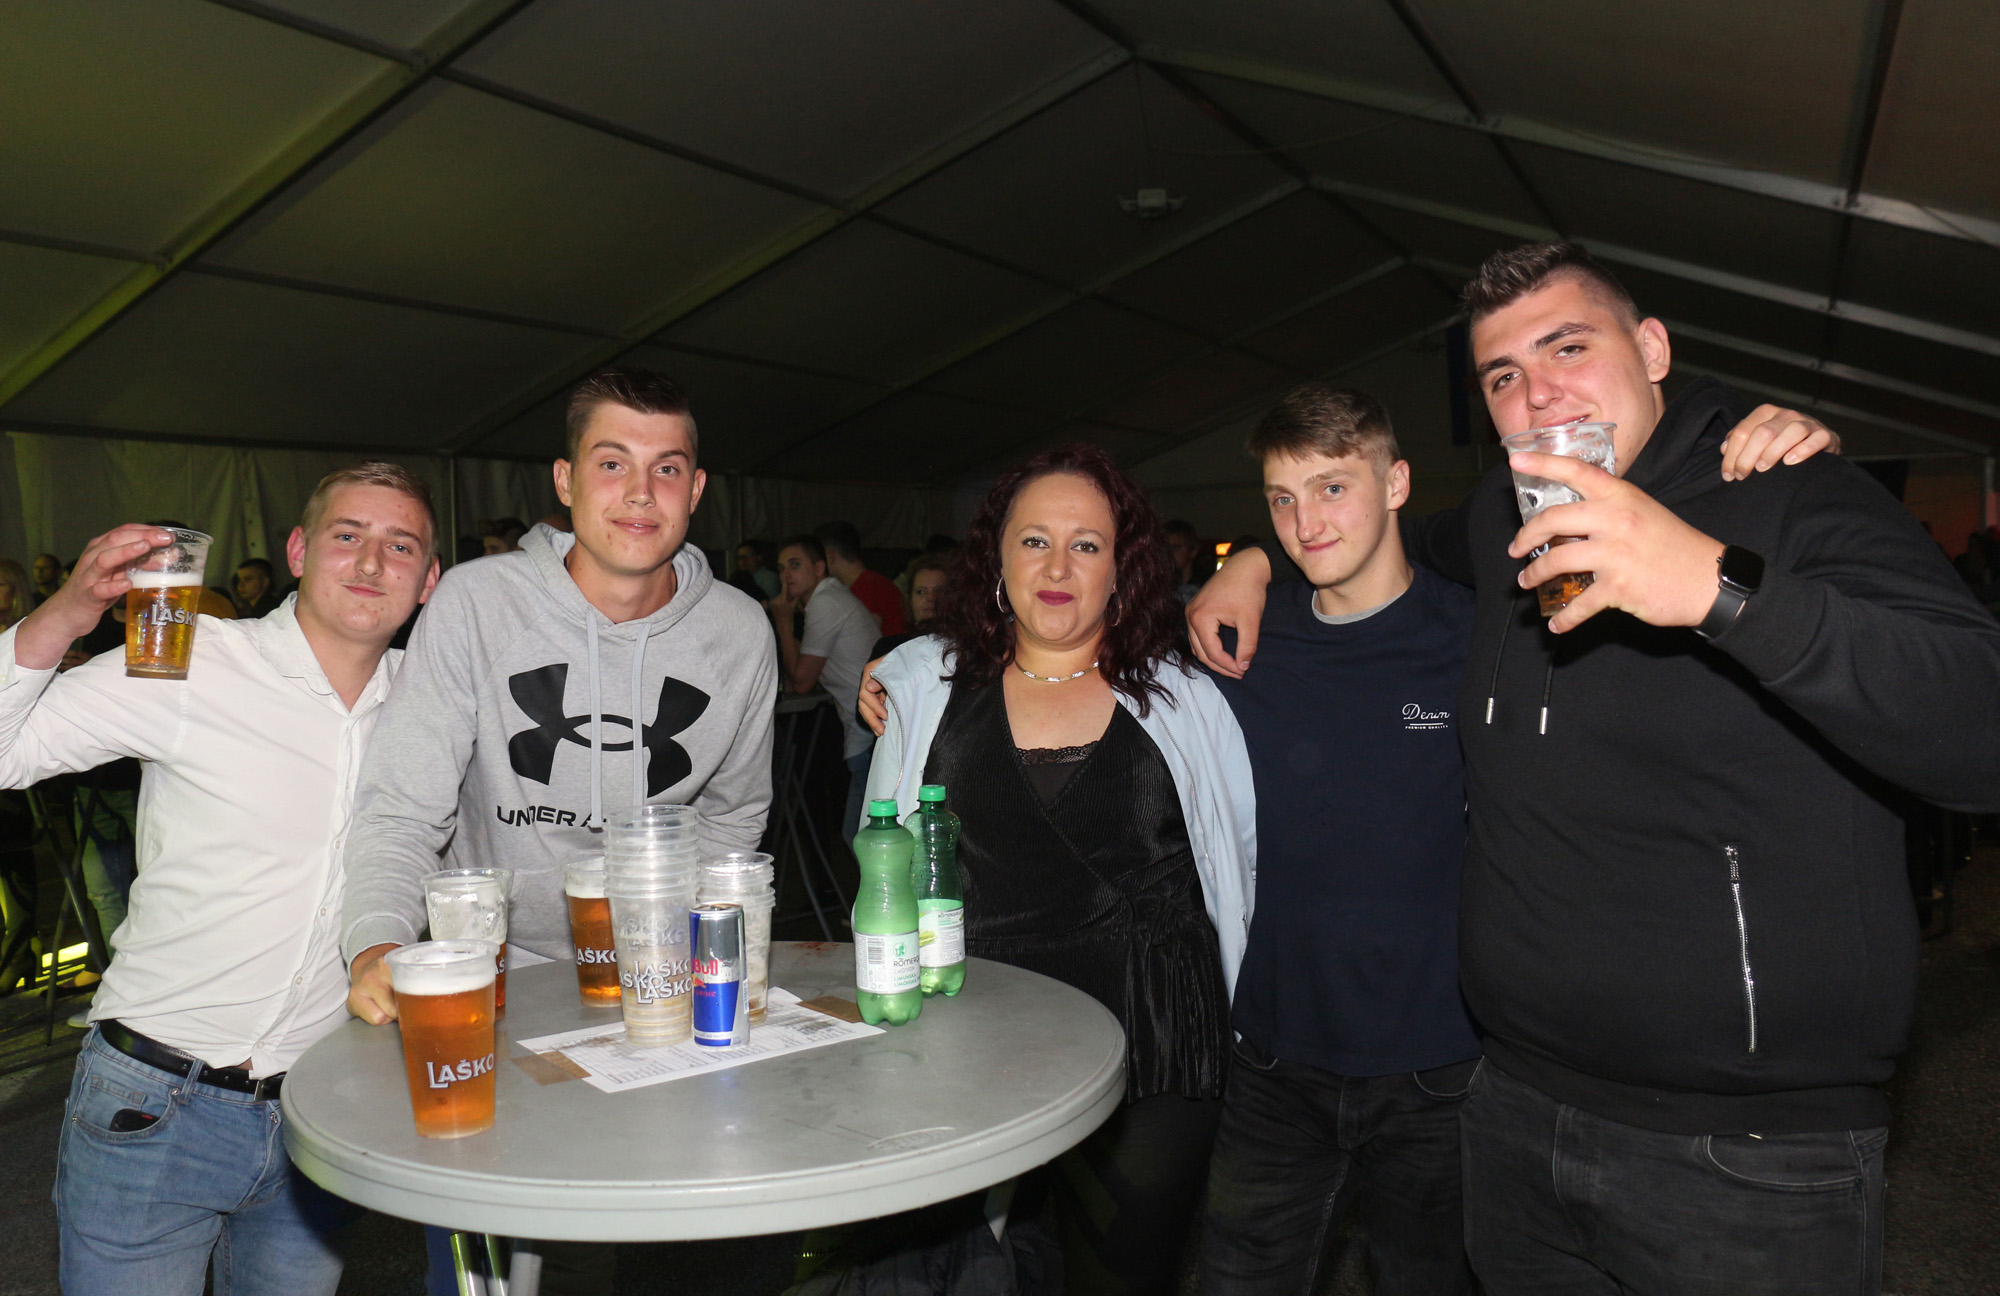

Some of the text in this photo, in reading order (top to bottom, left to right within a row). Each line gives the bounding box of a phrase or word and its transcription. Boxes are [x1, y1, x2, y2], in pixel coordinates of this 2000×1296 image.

[1402, 703, 1450, 720] Denim
[694, 958, 719, 976] Bull
[426, 1053, 495, 1089] LAŠKO
